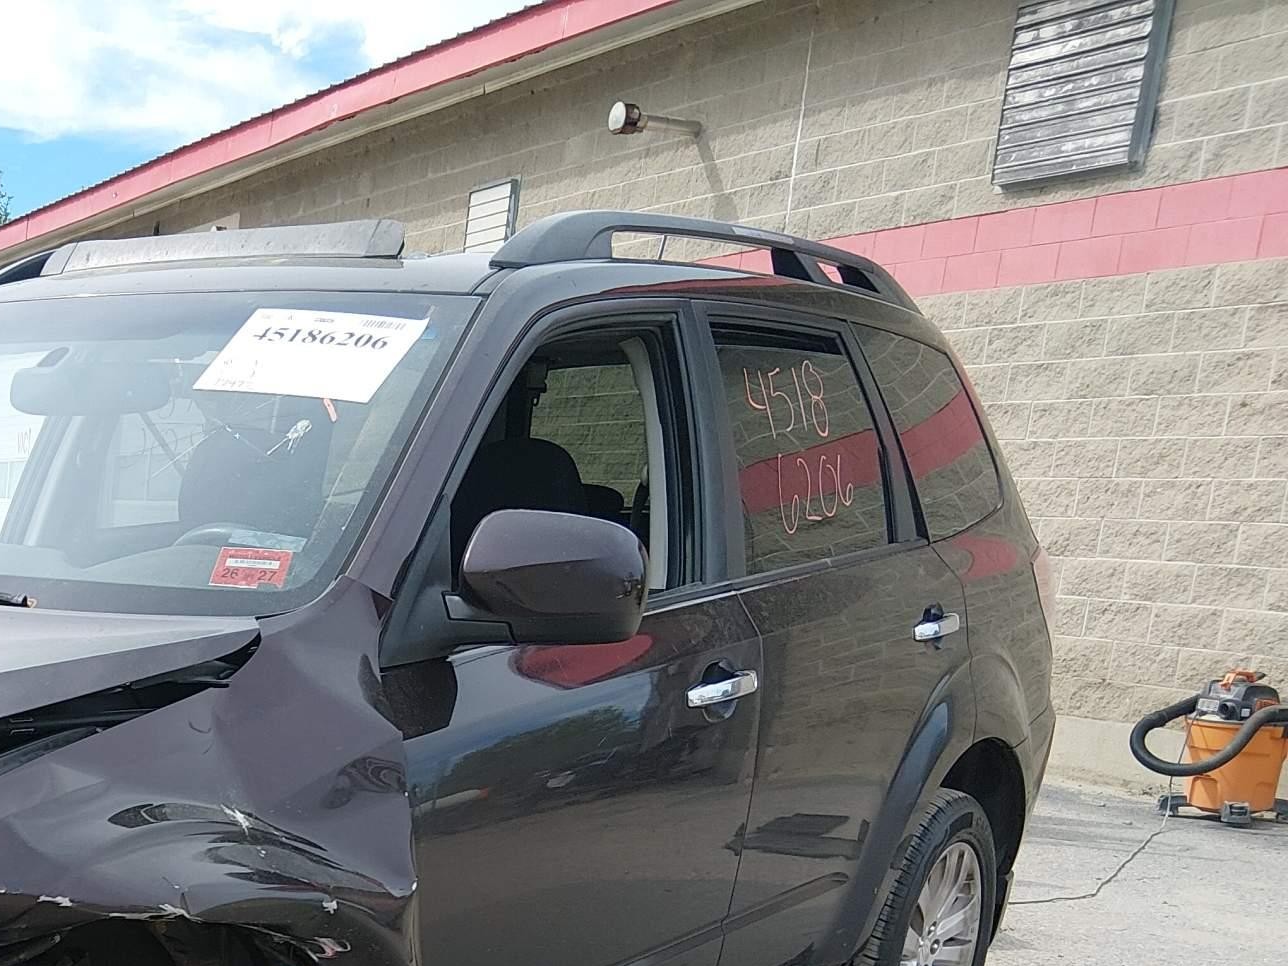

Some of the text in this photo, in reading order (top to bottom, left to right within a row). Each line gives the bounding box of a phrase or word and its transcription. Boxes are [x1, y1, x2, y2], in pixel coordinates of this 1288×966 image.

[253, 325, 391, 350] 45186206
[743, 360, 830, 438] 4518
[777, 452, 854, 535] 6206
[221, 567, 278, 582] 26 27
